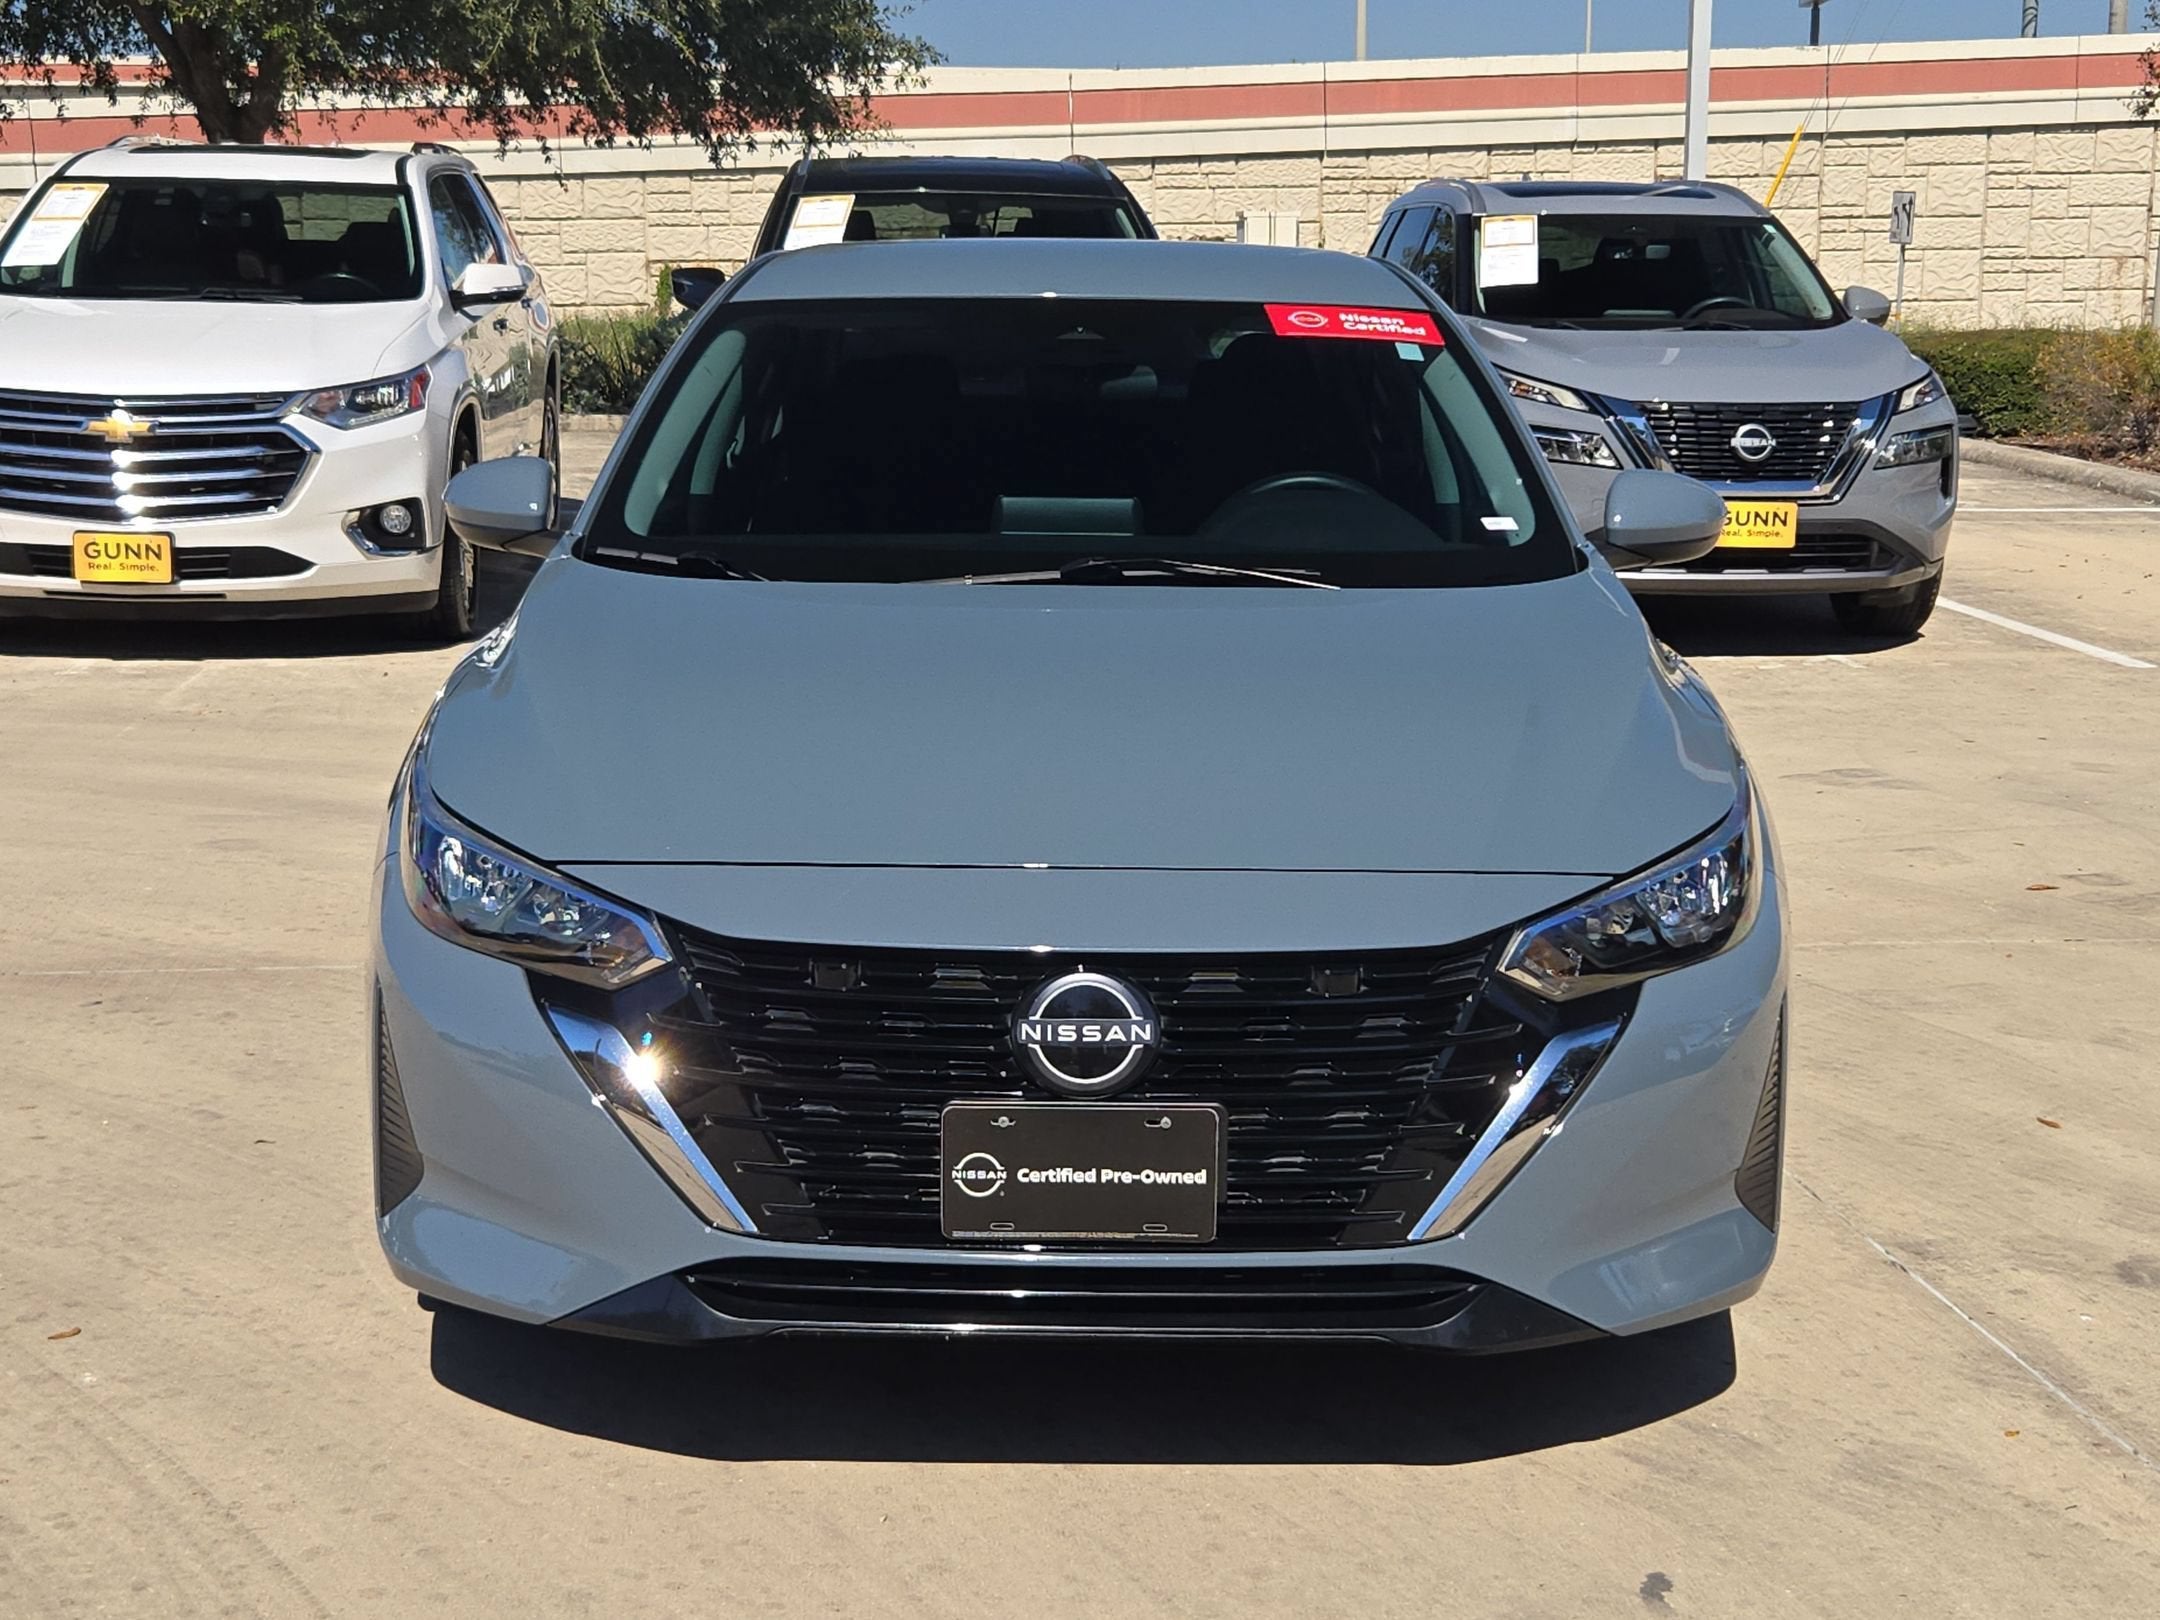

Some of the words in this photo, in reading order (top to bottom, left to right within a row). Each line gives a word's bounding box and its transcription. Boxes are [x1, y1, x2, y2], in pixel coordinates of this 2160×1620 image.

[1339, 312, 1405, 326] Nissan
[1343, 321, 1427, 336] Certified
[1730, 437, 1776, 447] SSAN
[1746, 529, 1784, 538] Simple.
[83, 541, 162, 561] GUNN
[88, 562, 116, 571] Real.
[119, 562, 159, 572] Simple.
[1020, 1023, 1151, 1042] NISSAN
[951, 1169, 1007, 1180] NISSAN
[1017, 1167, 1097, 1184] Certified
[1100, 1168, 1207, 1185] Pre-Owned
